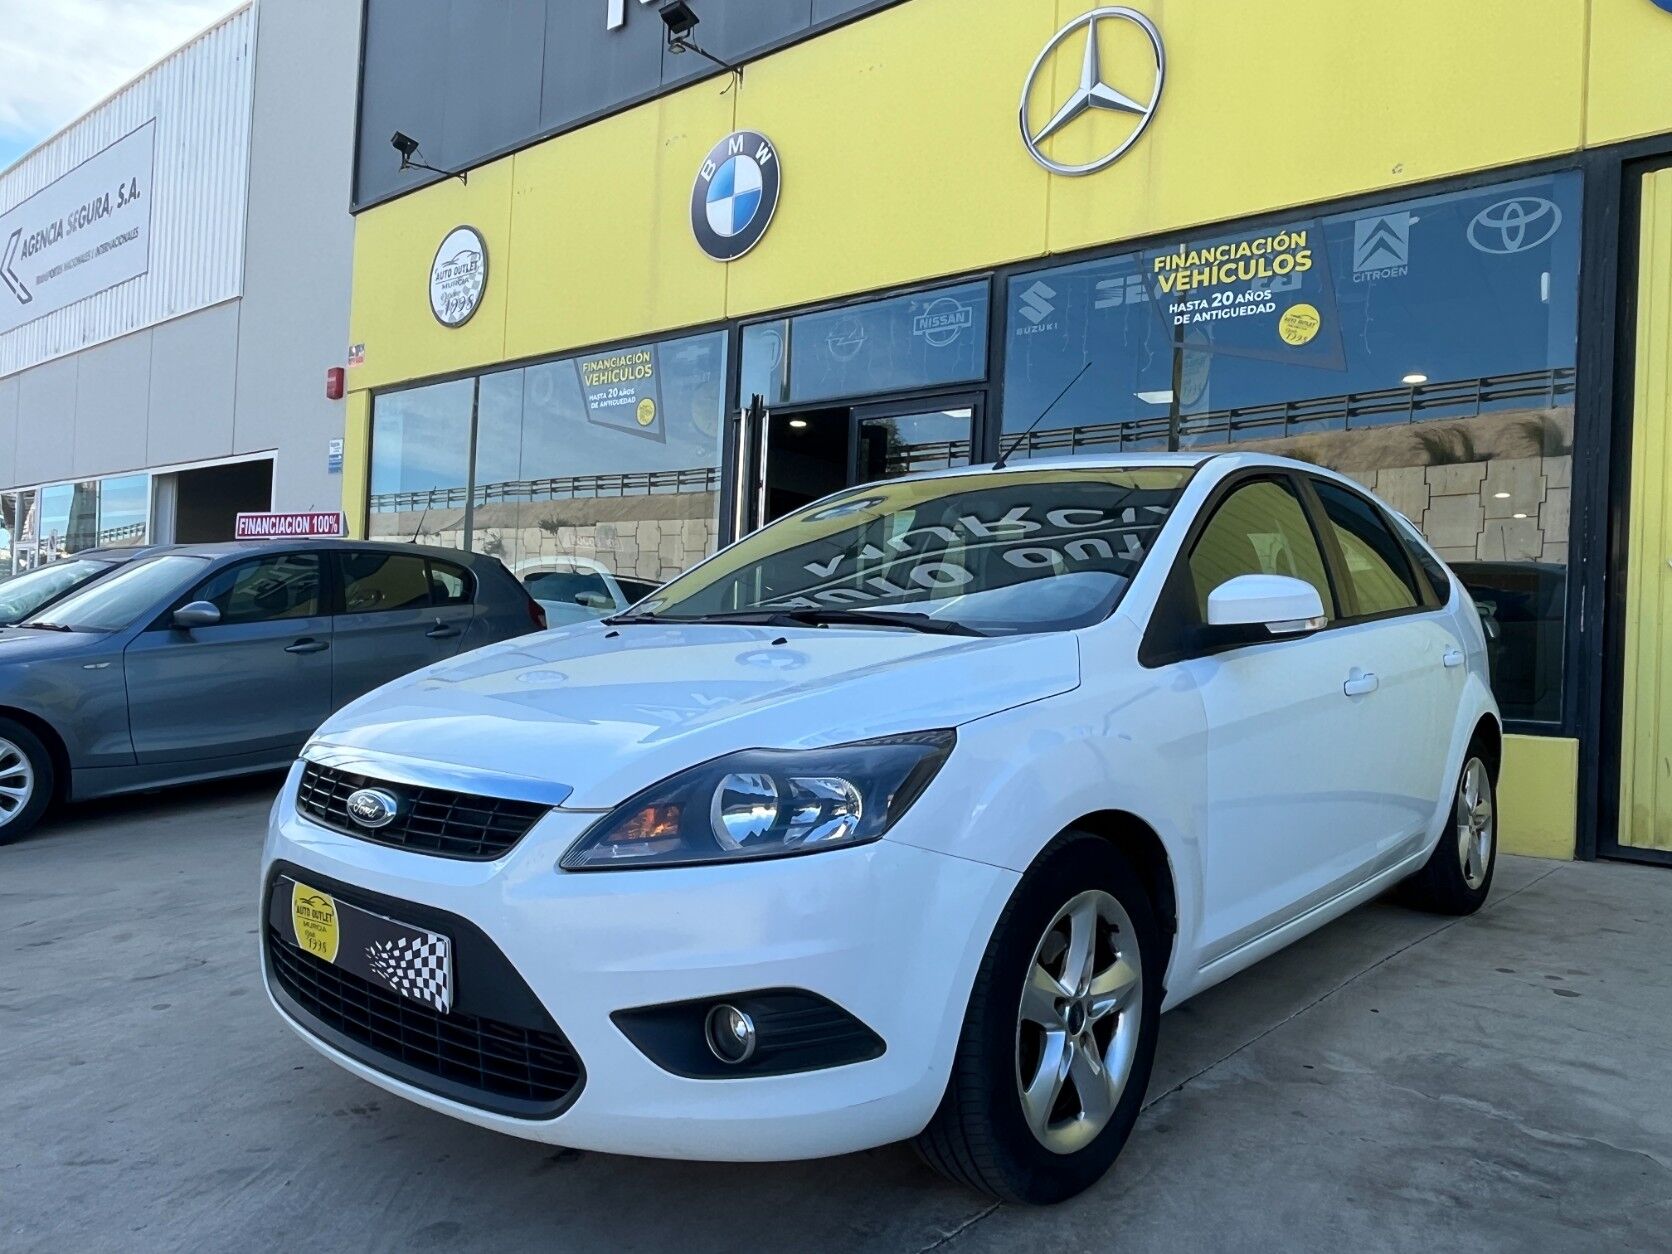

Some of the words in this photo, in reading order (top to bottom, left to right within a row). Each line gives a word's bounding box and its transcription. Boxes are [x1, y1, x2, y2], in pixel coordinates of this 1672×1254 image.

[701, 134, 772, 182] BMW
[21, 218, 64, 261] AGENCIA
[66, 192, 113, 236] SEGURA,
[117, 177, 140, 208] S.A.
[1154, 231, 1307, 272] FINANCIACIÓN
[436, 268, 452, 281] AUTO
[454, 261, 478, 276] OUTLET
[1158, 250, 1313, 293] VEHÍCULOS
[445, 293, 474, 315] 1998
[1169, 300, 1208, 314] HASTA
[1211, 291, 1234, 307] 20
[1235, 290, 1272, 304] AÑOS
[919, 312, 966, 330] NISSAN
[1174, 315, 1190, 325] DE
[1193, 302, 1276, 323] ANTIGUEDAD
[583, 351, 650, 373] FINANCIACIÓN
[585, 364, 652, 386] VEHÍCULOS
[608, 388, 618, 398] 20
[239, 516, 310, 534] FINANCIACION
[313, 515, 338, 533] 100%
[353, 796, 379, 818] Ford
[296, 905, 310, 917] AUTO
[312, 910, 332, 923] OUTLET
